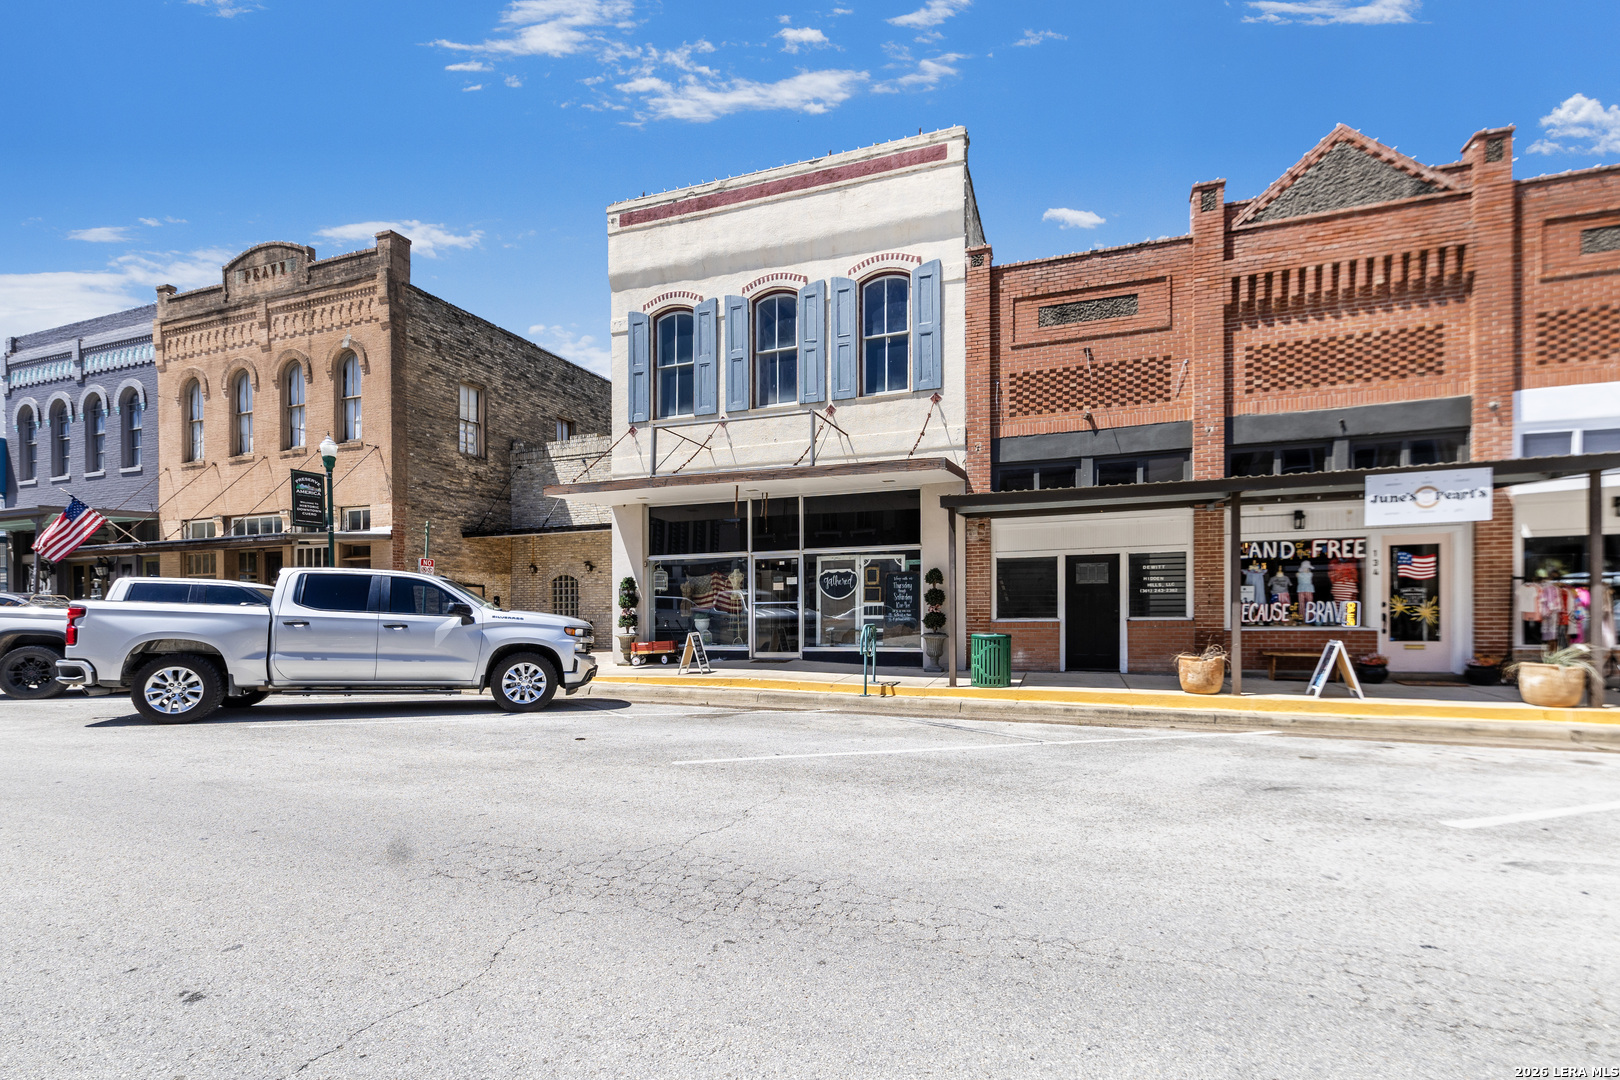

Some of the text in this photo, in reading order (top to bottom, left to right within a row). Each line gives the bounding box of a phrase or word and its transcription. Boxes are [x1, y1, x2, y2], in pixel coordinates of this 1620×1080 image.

[295, 477, 321, 487] PRESERVE
[1370, 492, 1418, 504] June's
[1312, 539, 1366, 559] FREE
[823, 574, 855, 590] gathered
[1240, 602, 1291, 623] ECAUSE
